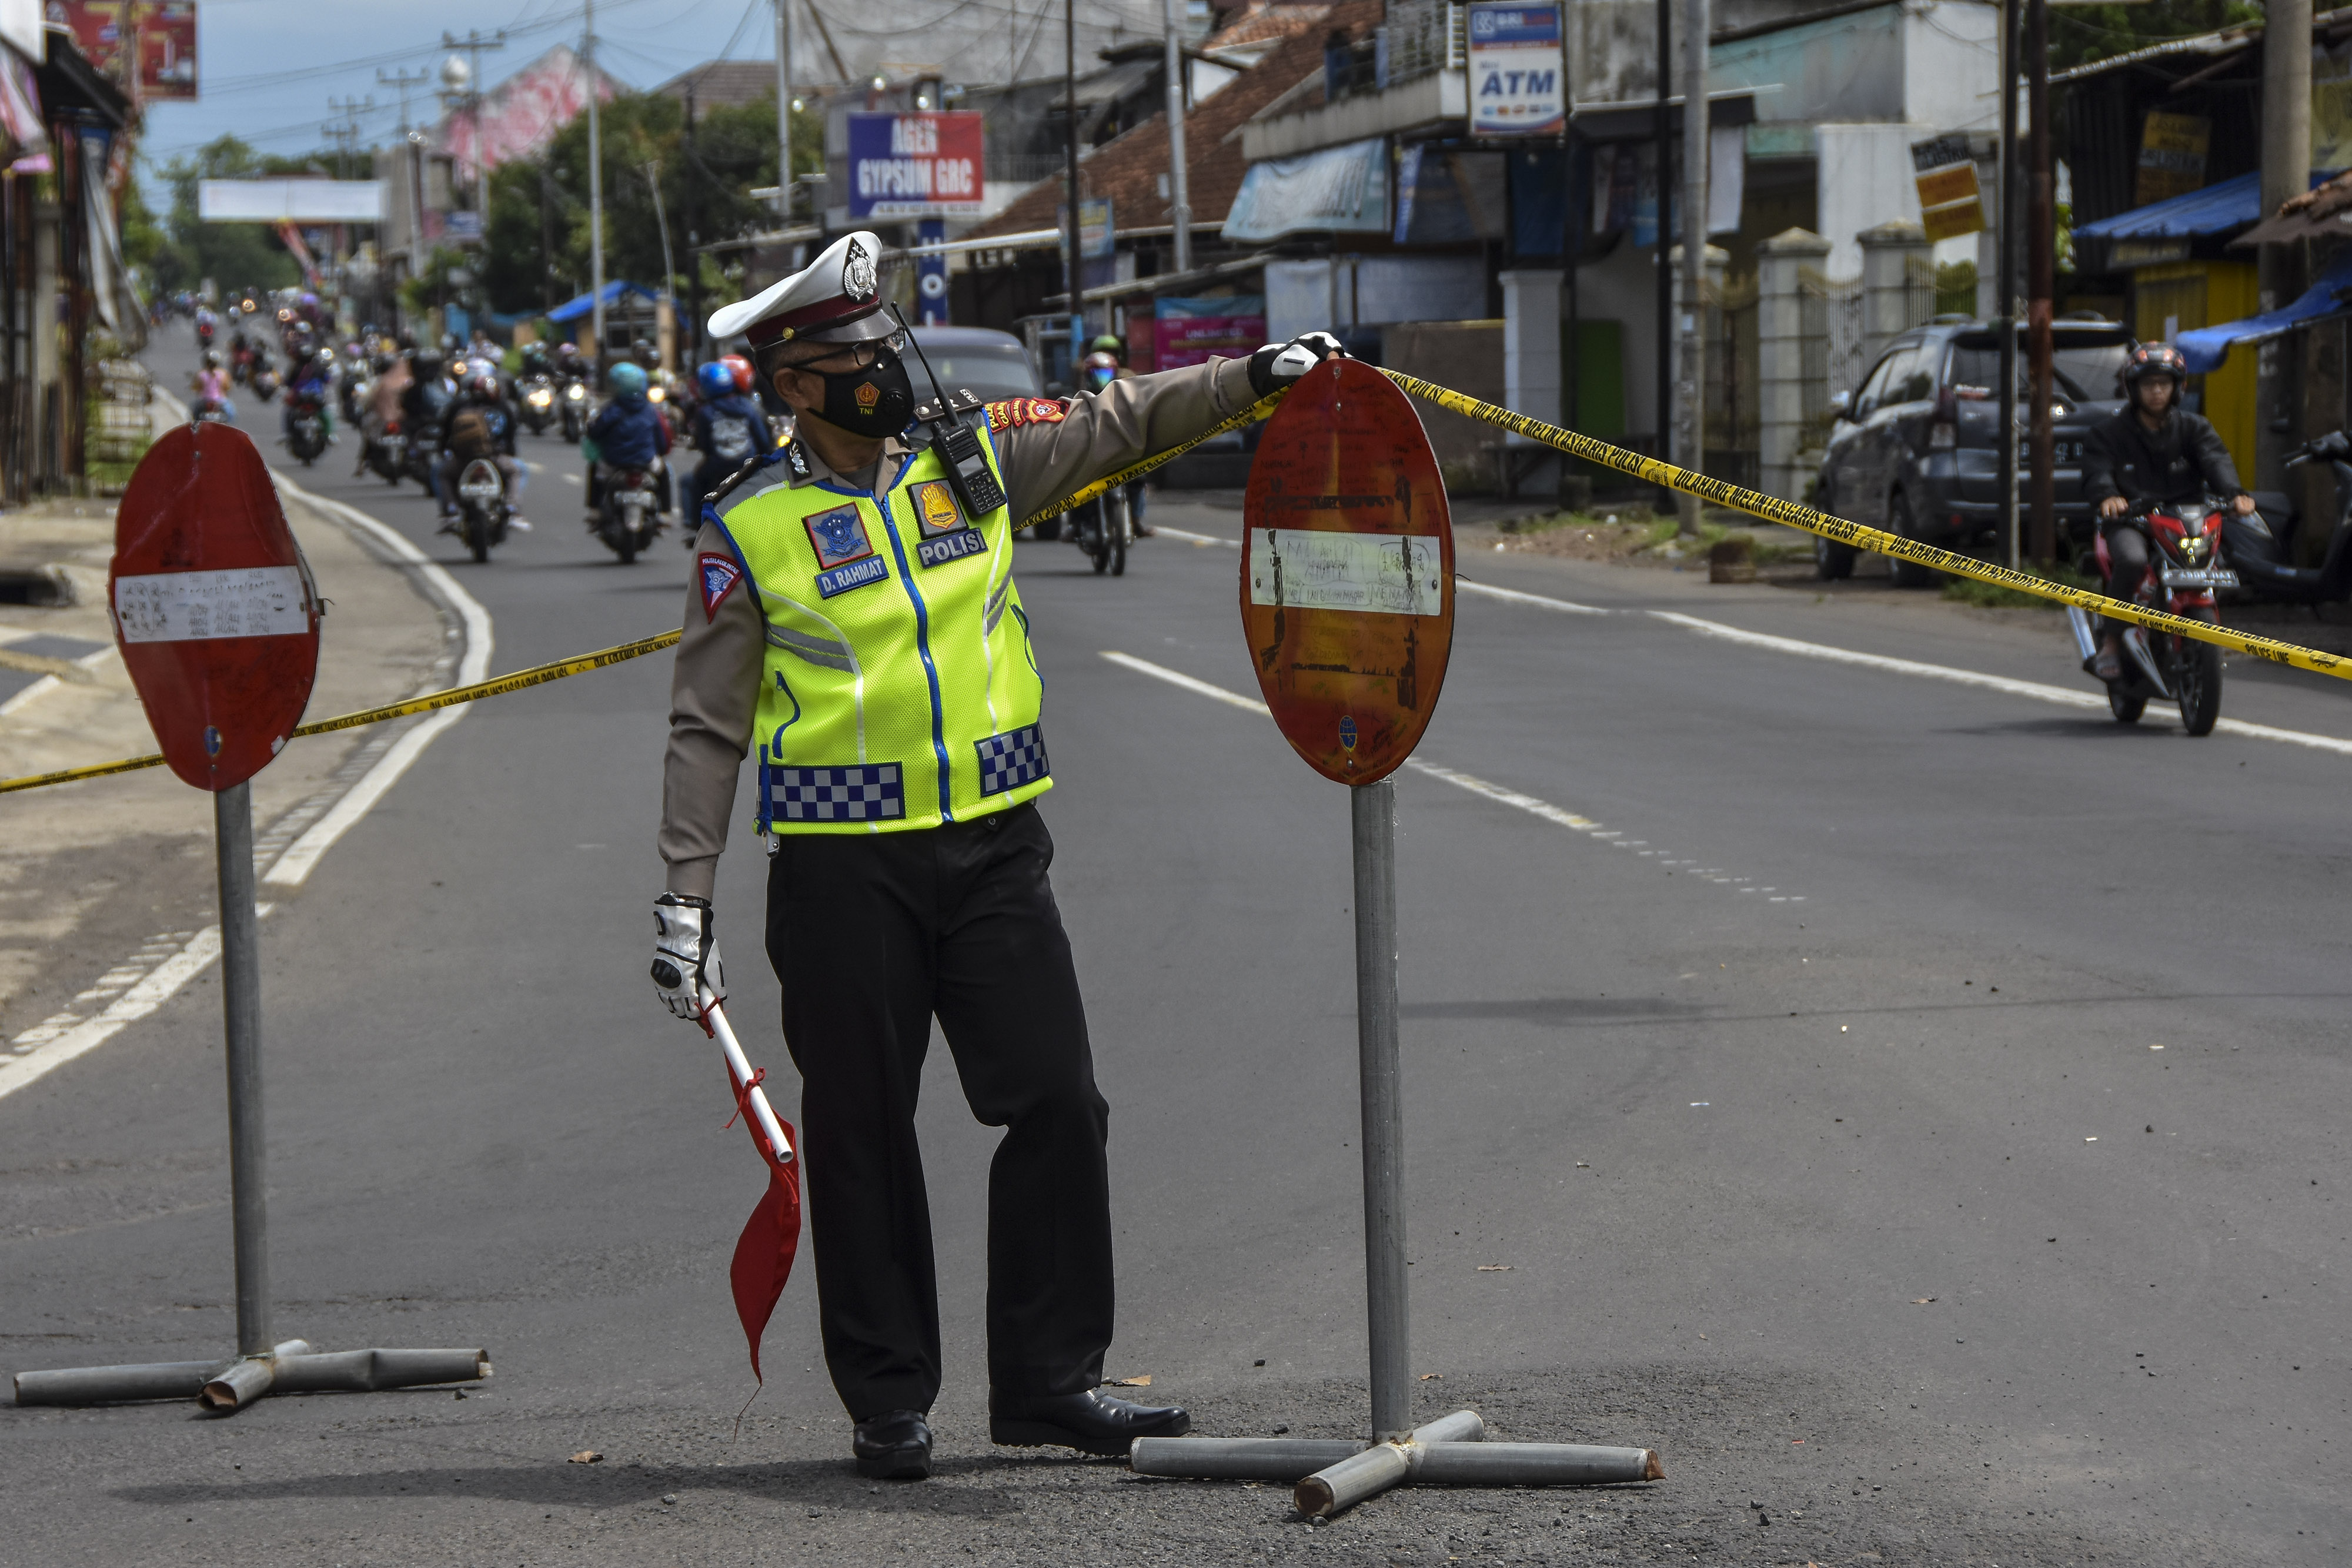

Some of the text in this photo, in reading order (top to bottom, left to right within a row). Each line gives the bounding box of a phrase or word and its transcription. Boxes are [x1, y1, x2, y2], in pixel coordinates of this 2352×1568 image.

[1479, 69, 1556, 96] ATM
[891, 118, 938, 154] AGEN
[858, 158, 974, 196] GYPSUM GRC
[1409, 378, 1447, 403] POLISI
[1471, 401, 1647, 474] DILARANG MELINTAS GARIS POLISI
[1673, 469, 1861, 540] DILARANG MELINTAS GARIS POLISI
[919, 531, 985, 565] POLISI
[1887, 536, 1948, 564] DILARANG
[1944, 553, 2006, 579] MELINTAS
[821, 559, 883, 592] D. RAHMAT
[2149, 620, 2163, 631] NOT
[2164, 624, 2188, 636] CROSS
[2245, 643, 2271, 659] POLICE
[2273, 650, 2290, 664] LINE
